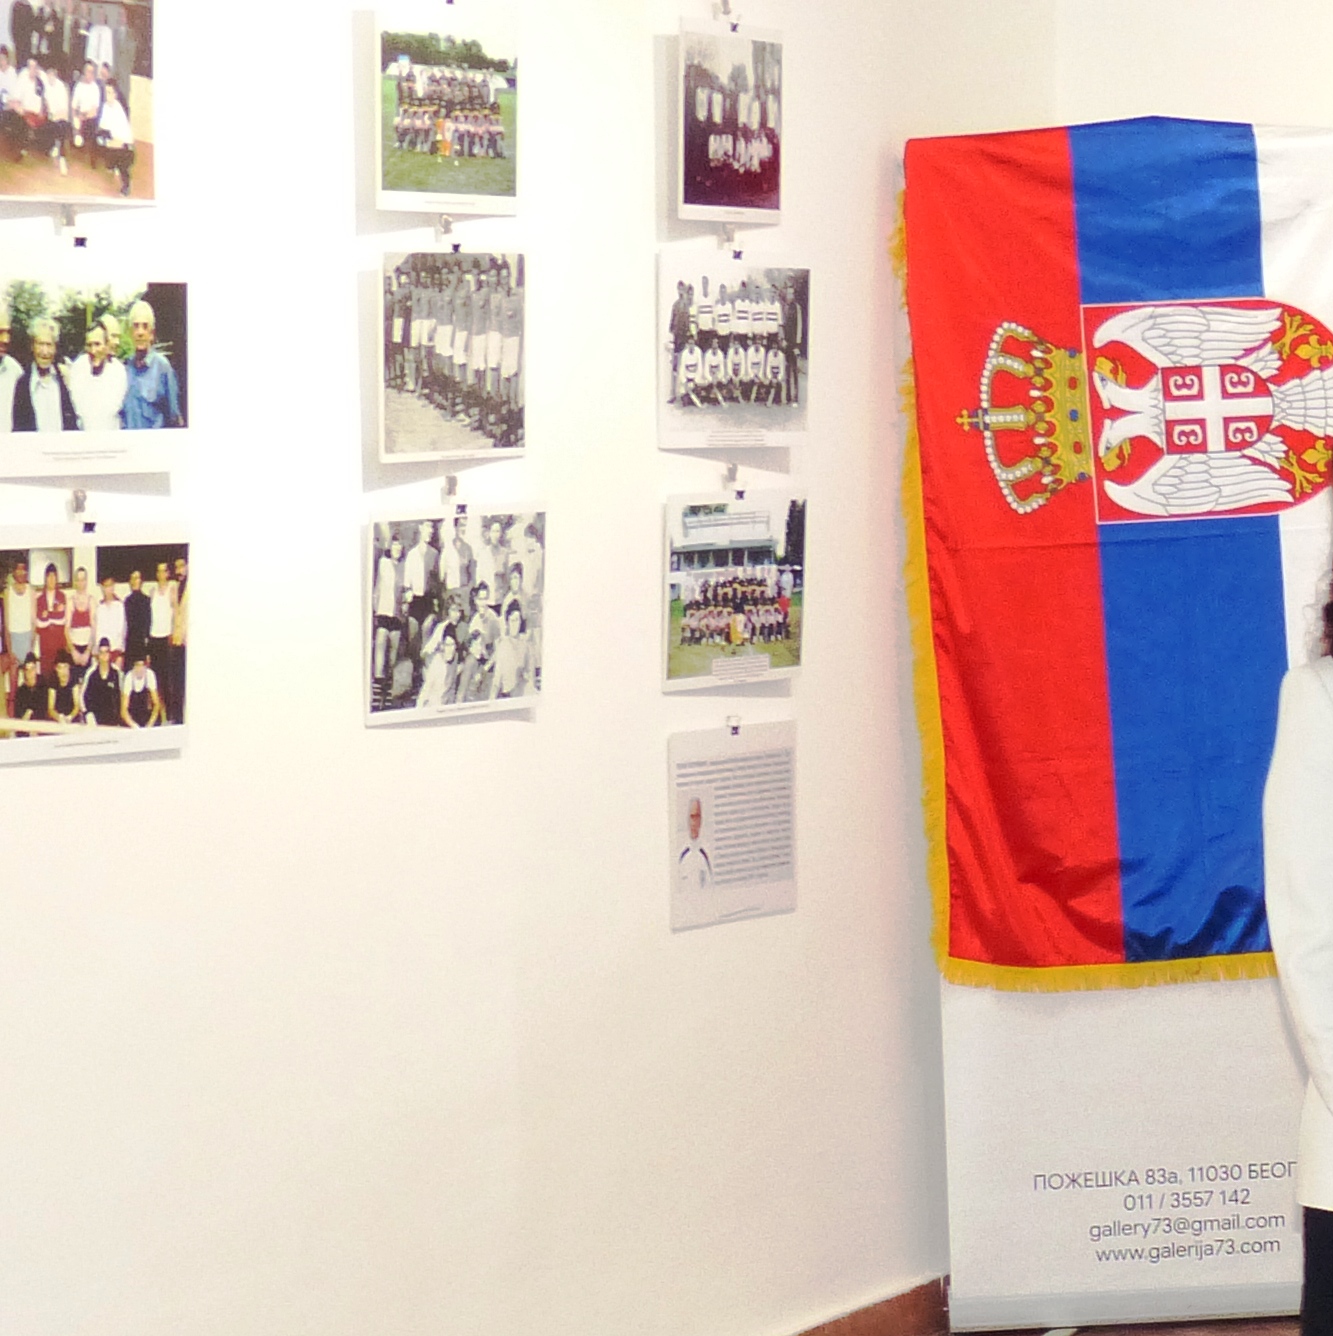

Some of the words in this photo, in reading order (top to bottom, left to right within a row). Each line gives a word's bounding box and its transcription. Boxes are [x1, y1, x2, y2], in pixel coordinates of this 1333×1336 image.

[1033, 1169, 1140, 1191] ПОЖЕШКА
[1145, 1168, 1183, 1186] 83а,
[1188, 1164, 1242, 1182] 11030
[1123, 1193, 1153, 1212] 011
[1158, 1193, 1166, 1210] /
[1170, 1190, 1214, 1209] 3557
[1219, 1188, 1251, 1206] 142
[1089, 1213, 1286, 1243] gallery73@gmail.com
[1096, 1238, 1281, 1264] www.galerija73.com
